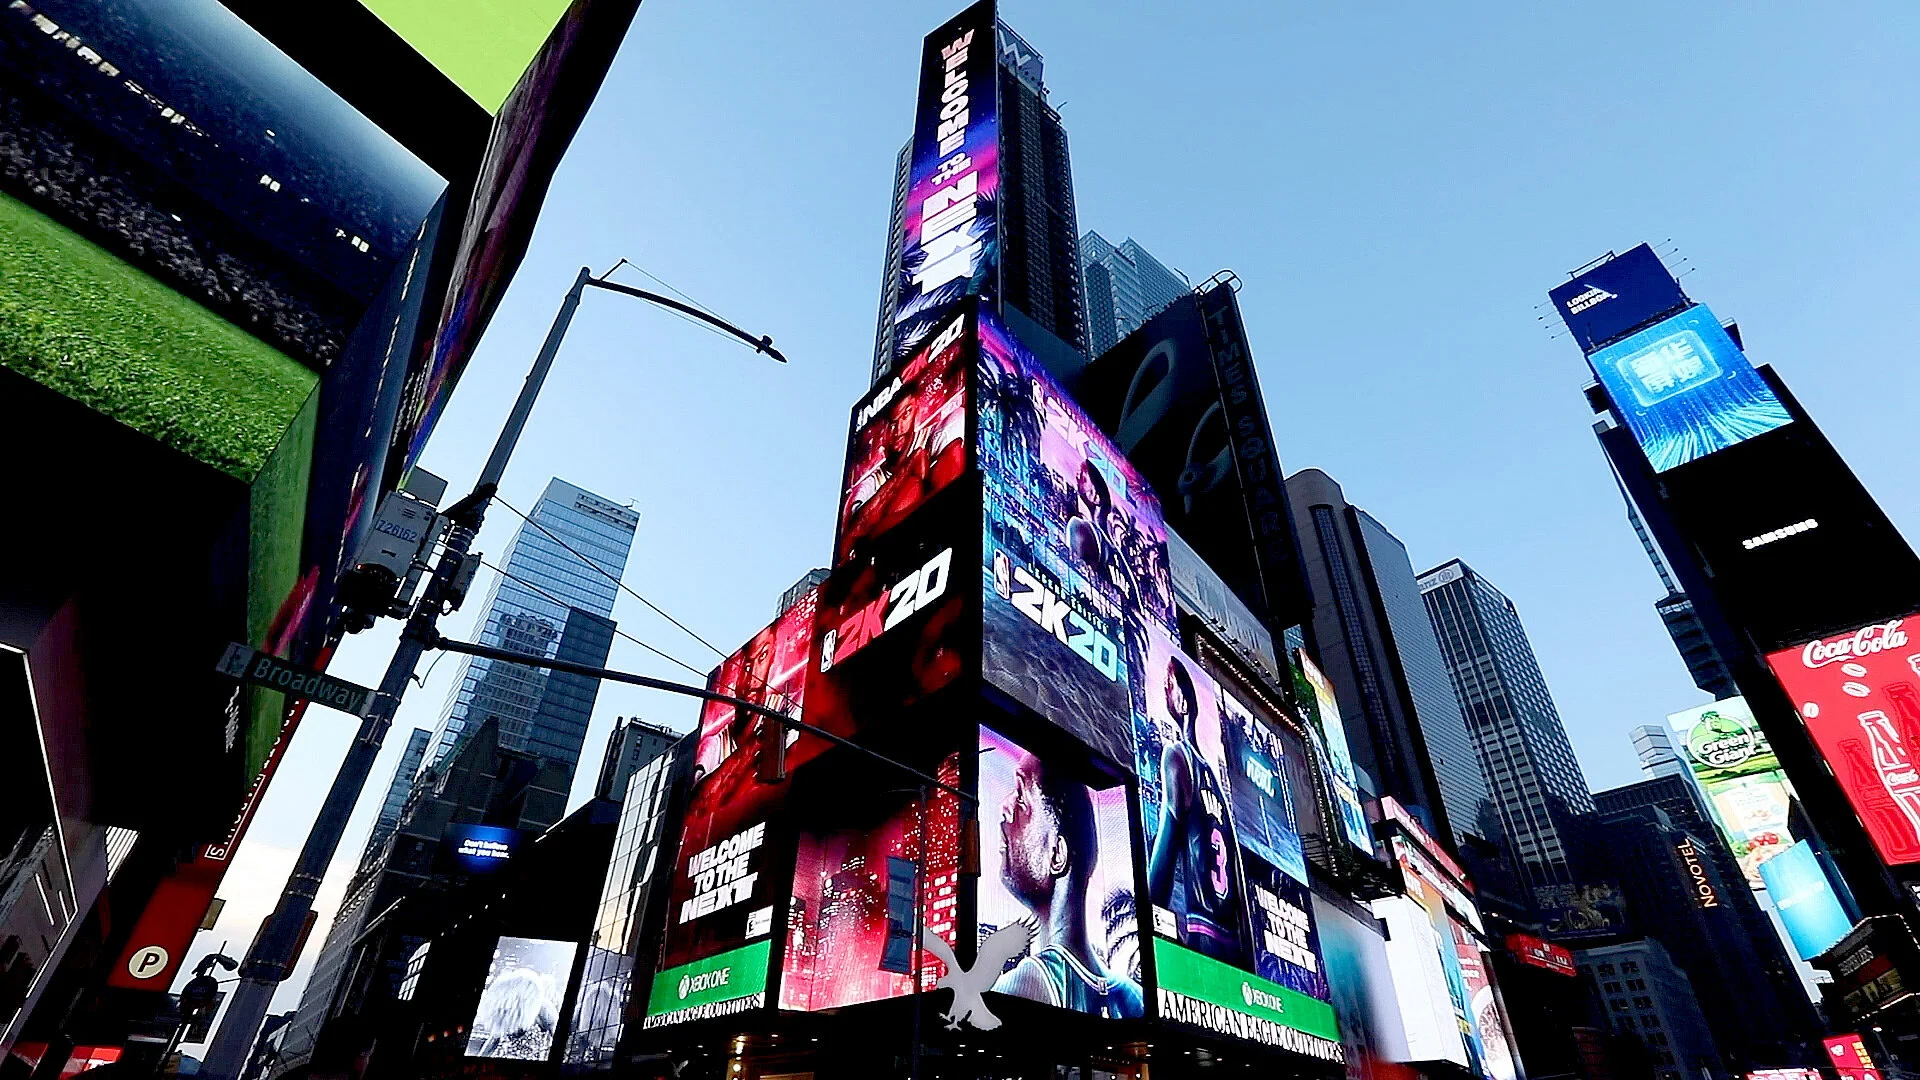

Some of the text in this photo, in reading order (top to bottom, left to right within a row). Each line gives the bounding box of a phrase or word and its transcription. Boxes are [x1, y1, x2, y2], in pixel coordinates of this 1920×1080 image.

[937, 28, 975, 158] WELCOME
[931, 157, 972, 186] THE
[938, 152, 966, 173] TO
[912, 170, 983, 296] NEXT
[1742, 518, 1819, 550] SAMSUNG
[833, 547, 952, 666] 2K20
[1011, 566, 1118, 682] 2K20
[1802, 619, 1909, 669] Coca-Cola
[253, 657, 363, 712] Broadway
[1701, 733, 1751, 755] Green
[1708, 745, 1757, 765] Giant
[687, 821, 766, 878] WELCOME
[694, 851, 750, 897] TO THE
[1677, 838, 1718, 908] NOVOTEL
[679, 871, 759, 925] NEXT
[1255, 884, 1310, 933] WELCOME
[1263, 929, 1318, 974] NEXT
[1267, 911, 1309, 950] TO THE
[138, 952, 160, 973] P
[688, 967, 731, 994] XBOX ONE
[1157, 988, 1249, 1040] AMERICAN
